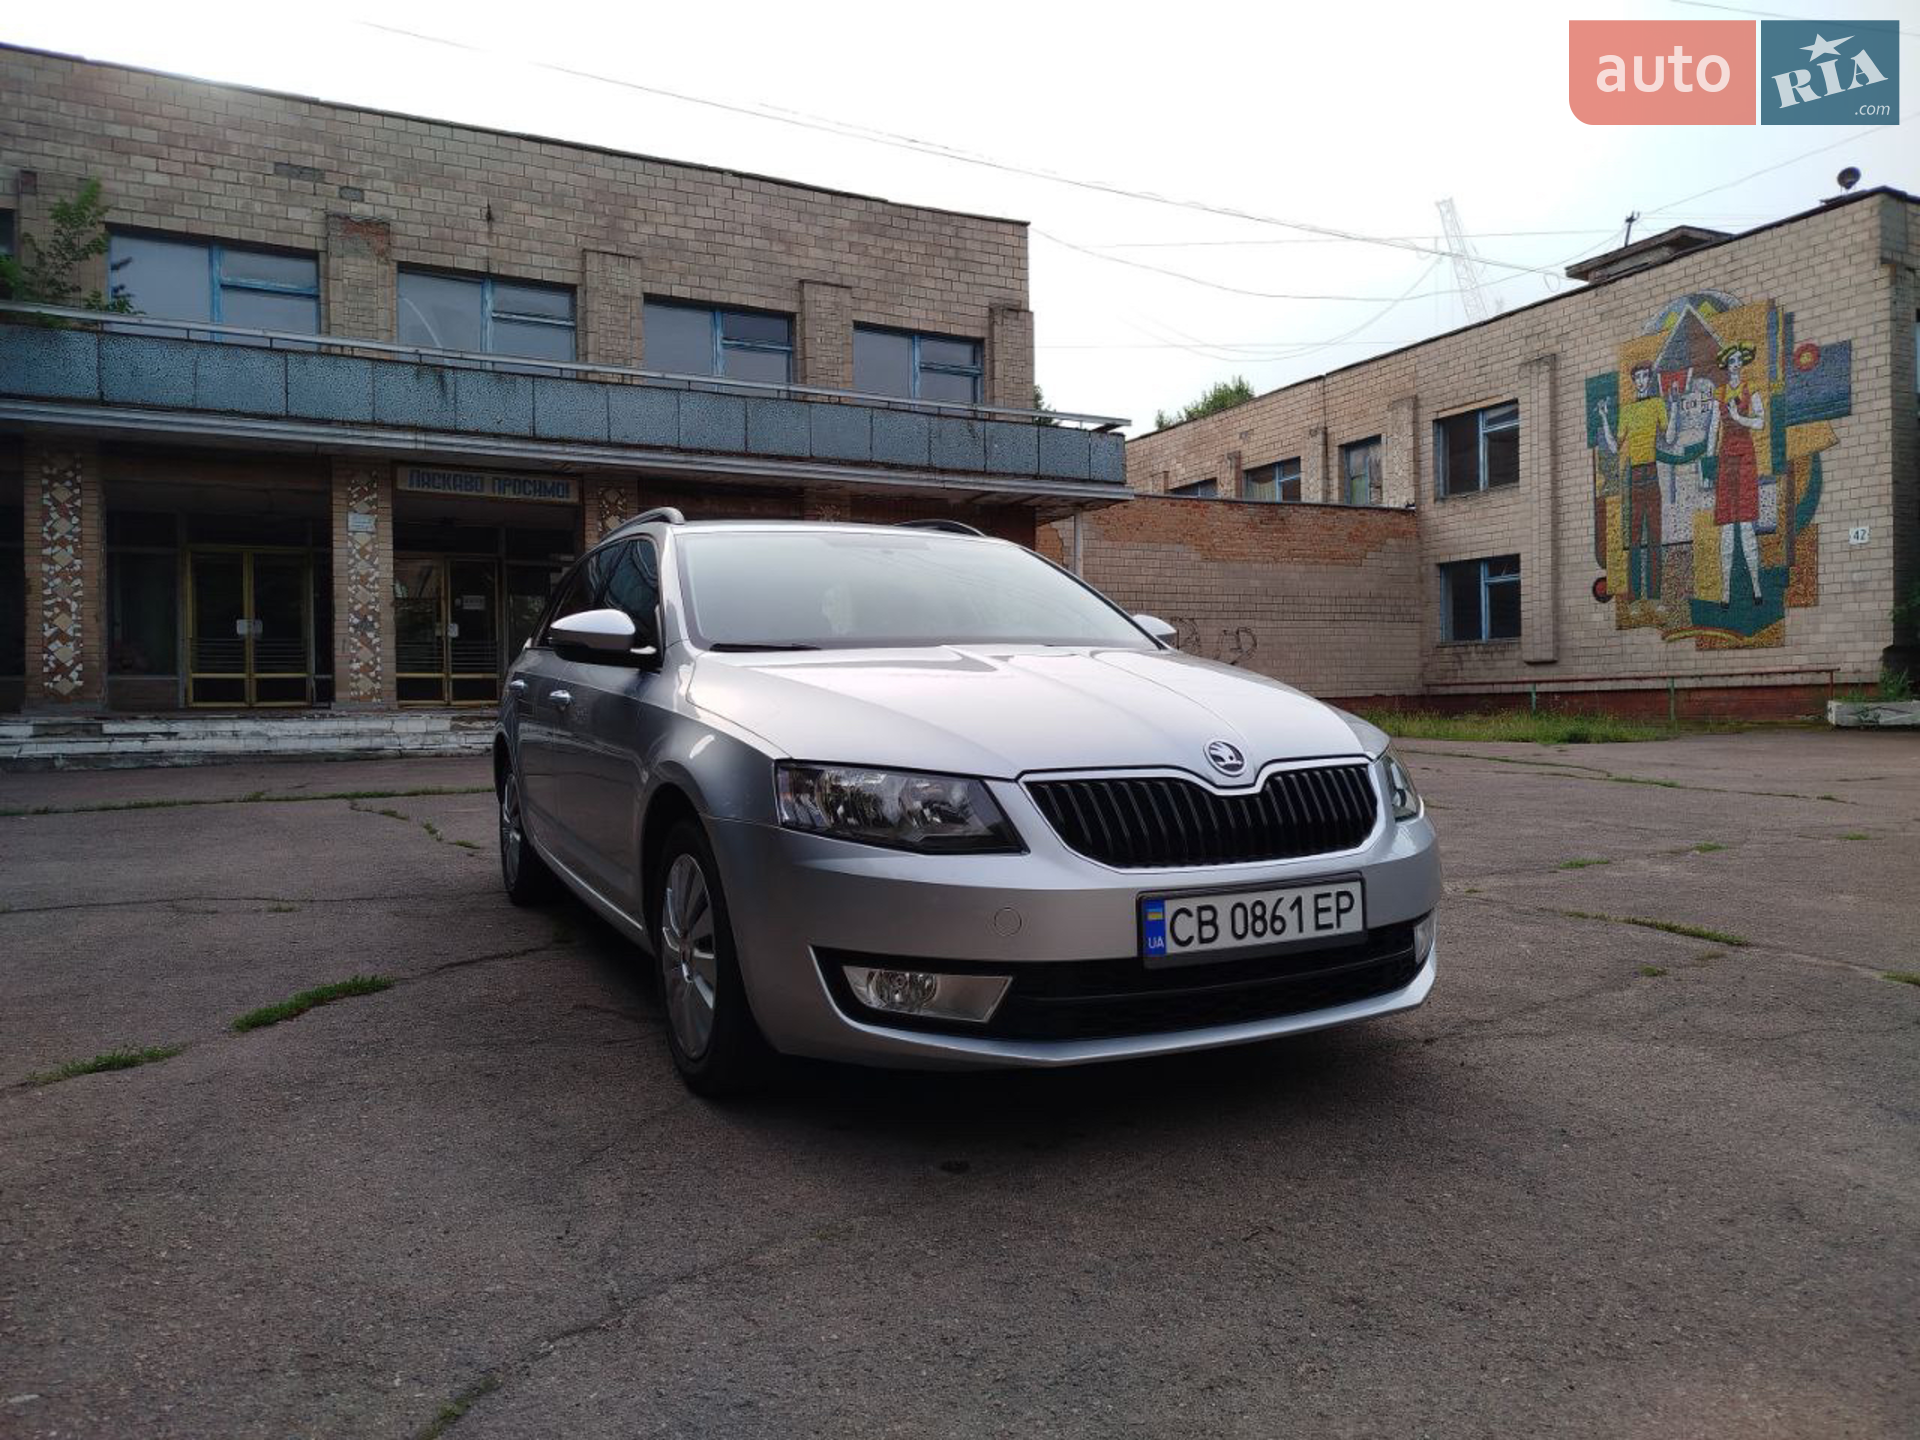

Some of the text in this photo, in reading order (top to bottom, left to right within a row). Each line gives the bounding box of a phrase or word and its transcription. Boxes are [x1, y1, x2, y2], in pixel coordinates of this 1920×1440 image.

[1853, 529, 1867, 541] 42
[1169, 890, 1355, 947] CB 0861 EP
[1148, 935, 1165, 949] UA
